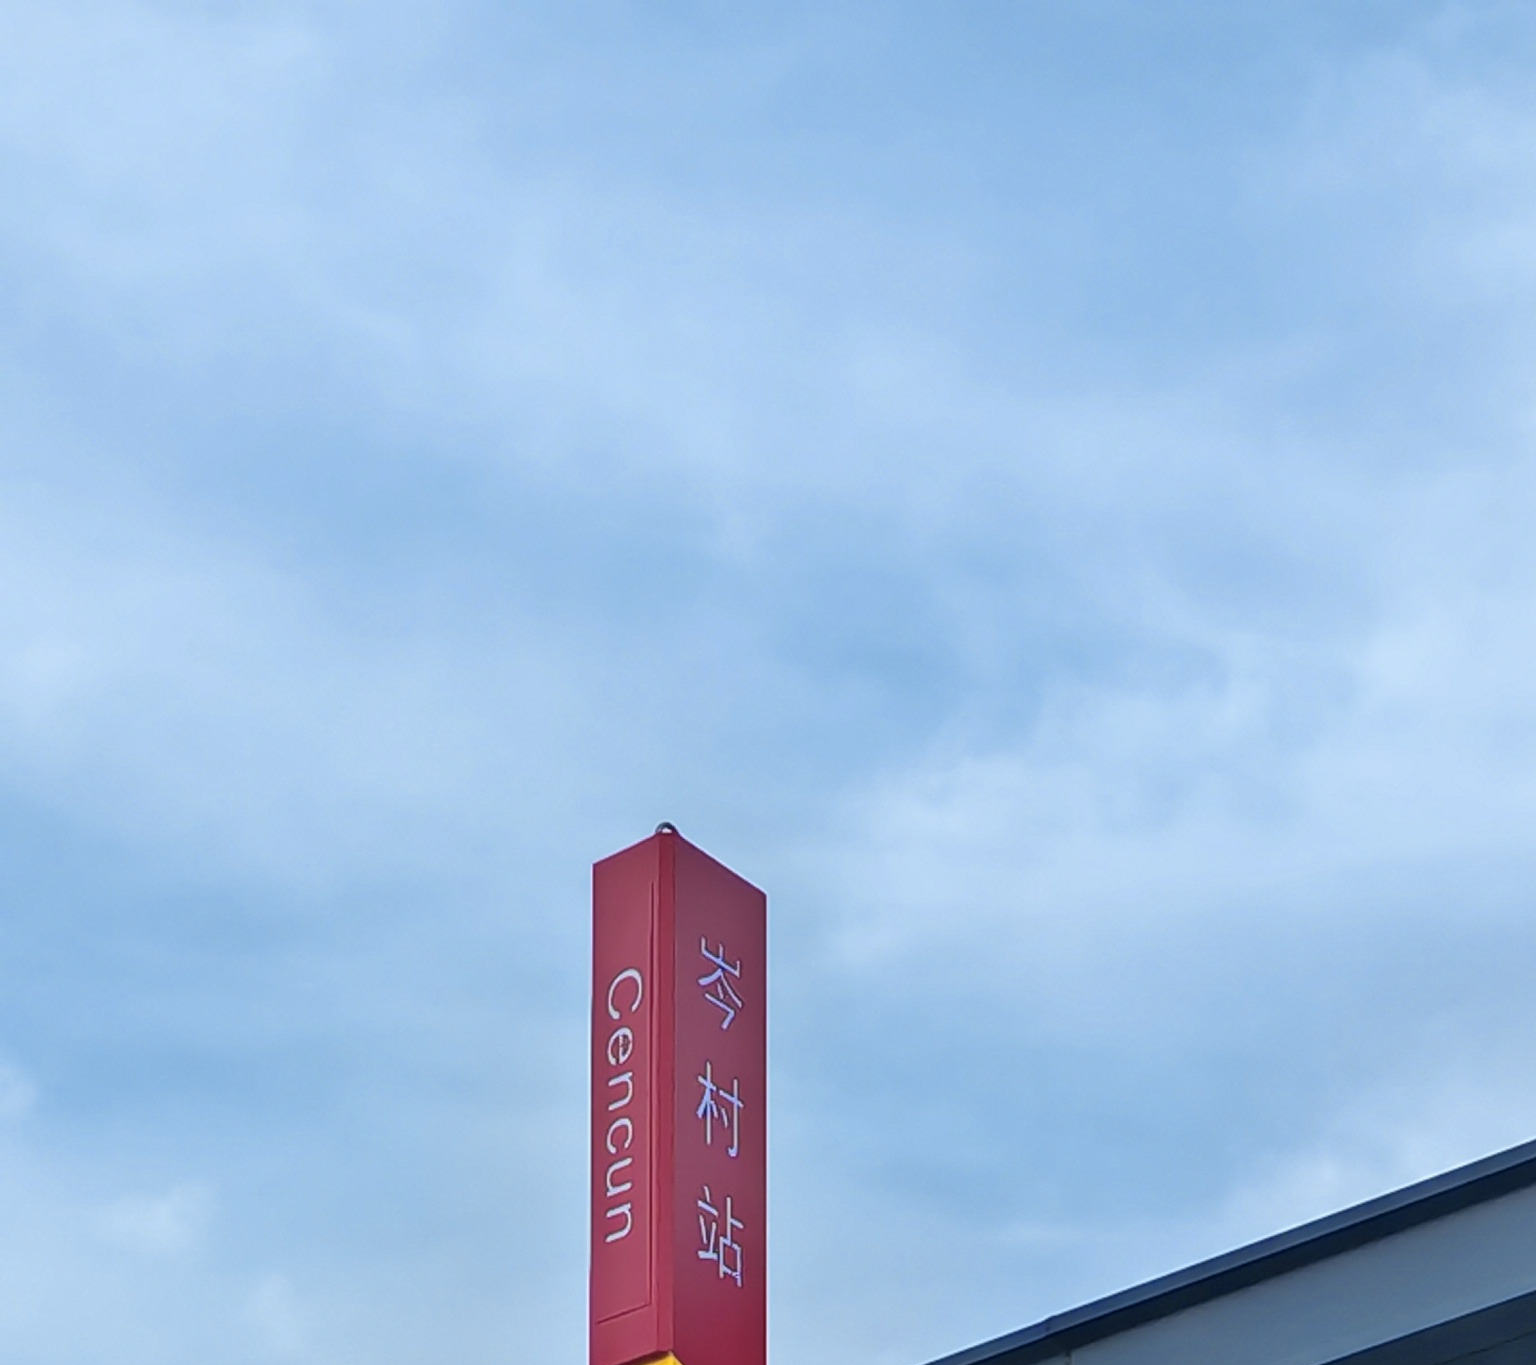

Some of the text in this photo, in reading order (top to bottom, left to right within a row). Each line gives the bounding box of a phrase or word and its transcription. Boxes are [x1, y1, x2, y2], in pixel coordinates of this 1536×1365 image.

[604, 968, 642, 1243] Cencun
[697, 936, 744, 1288] 岑村站
